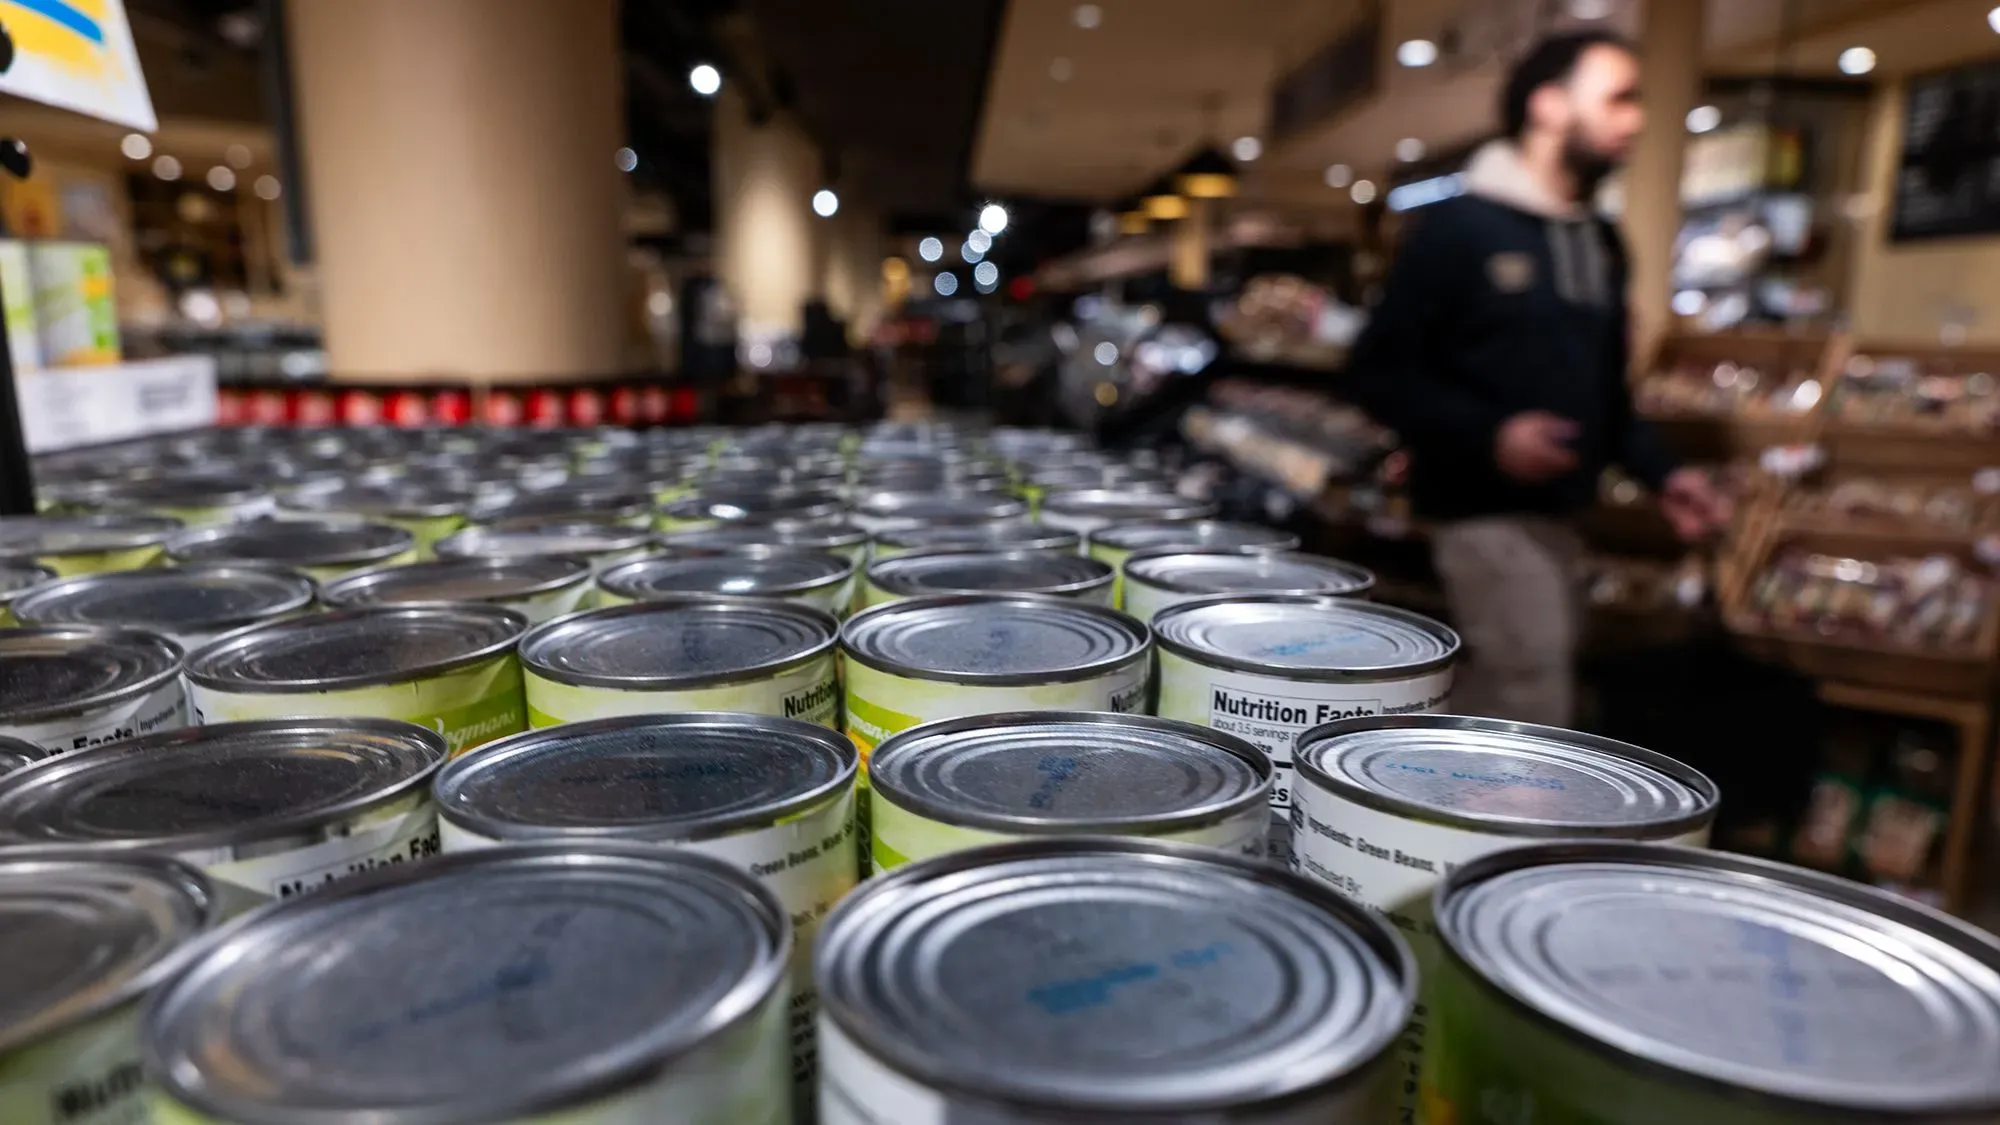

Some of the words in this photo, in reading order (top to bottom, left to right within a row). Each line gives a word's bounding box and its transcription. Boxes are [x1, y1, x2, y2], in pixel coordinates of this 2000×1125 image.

[1214, 690, 1308, 725] Nutrition
[1356, 836, 1391, 862] Green
[1393, 848, 1439, 875] Beans,
